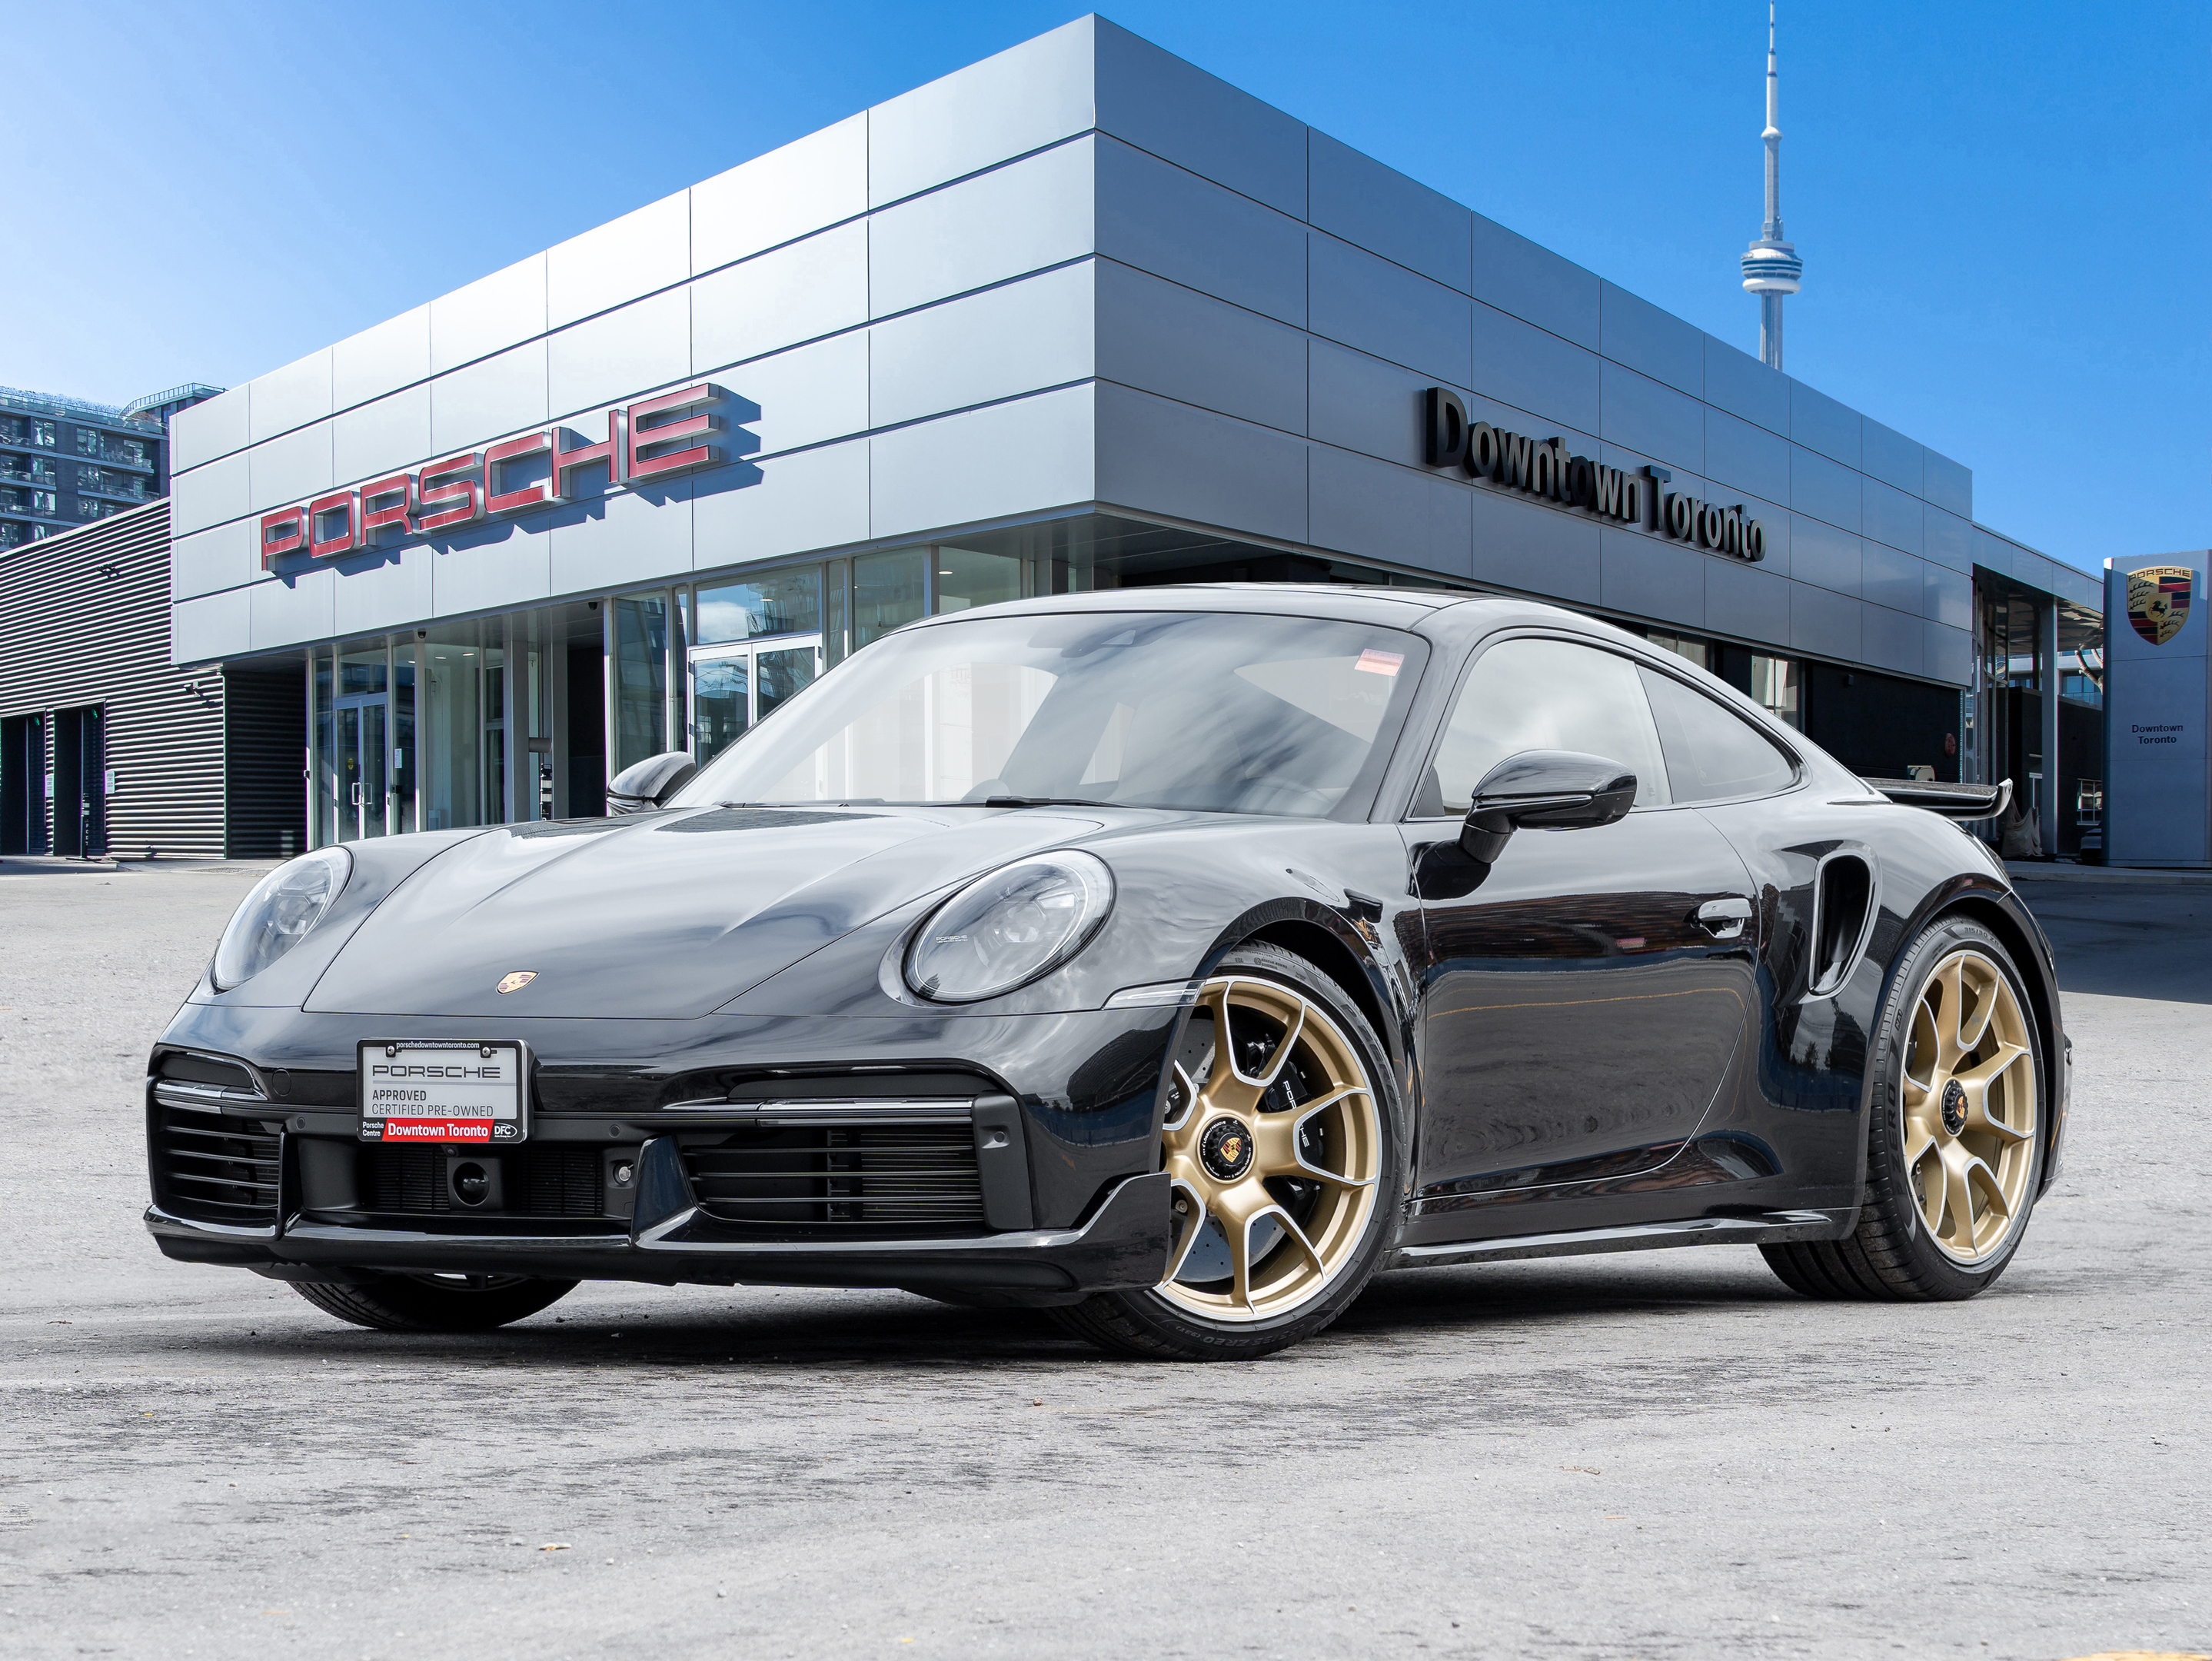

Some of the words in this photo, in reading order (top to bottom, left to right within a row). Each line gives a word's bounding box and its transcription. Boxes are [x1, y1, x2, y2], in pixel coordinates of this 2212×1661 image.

[261, 382, 720, 571] PORSCHE
[2129, 568, 2191, 582] PORSCHE
[2131, 724, 2184, 734] Downtown
[2137, 735, 2177, 744] Toronto
[396, 1041, 480, 1050] porschedowntowntoronto.com
[372, 1064, 501, 1079] PORSCHE
[372, 1090, 427, 1101] APPROVED
[372, 1103, 424, 1115] CERTIFIED
[427, 1105, 494, 1117] PRE-OWNED
[1282, 1080, 1310, 1147] PORHE
[388, 1123, 445, 1137] Downtown
[447, 1123, 488, 1137] Toronto
[494, 1126, 511, 1135] DFC
[1888, 1082, 1901, 1174] ZERO
